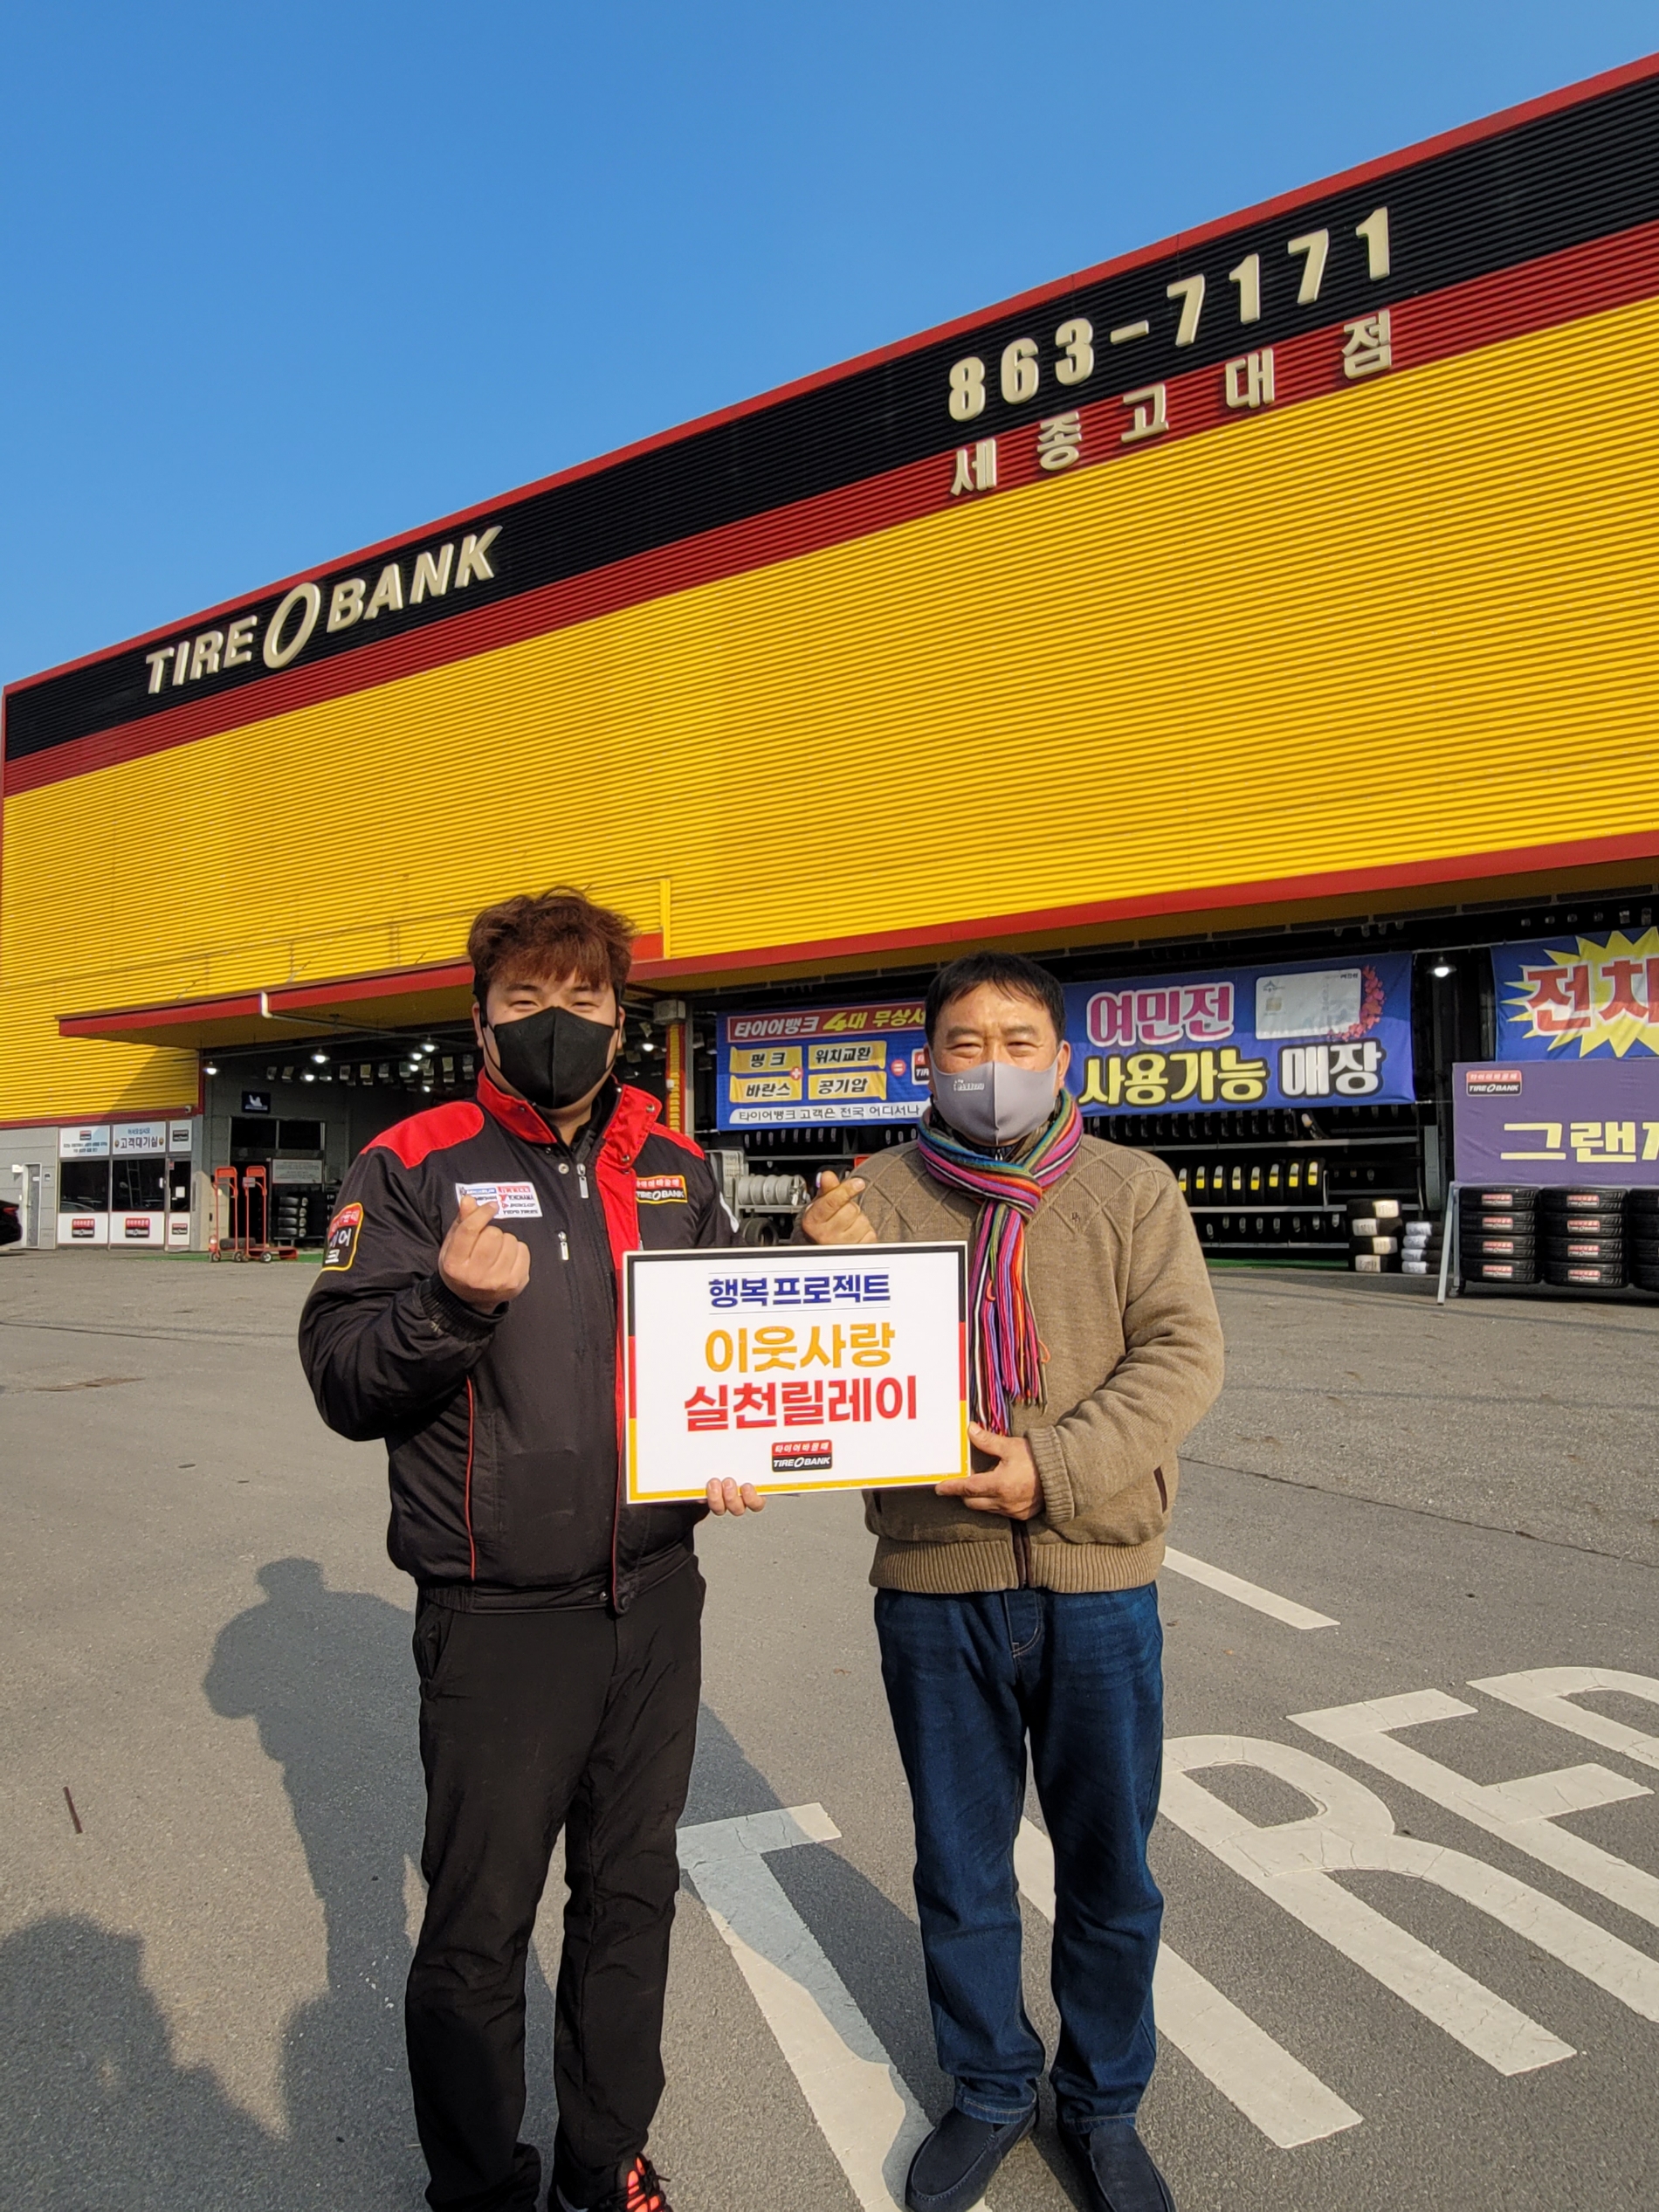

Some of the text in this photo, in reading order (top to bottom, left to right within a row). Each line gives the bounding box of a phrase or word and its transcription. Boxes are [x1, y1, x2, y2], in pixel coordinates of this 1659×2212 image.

[948, 206, 1390, 422] 863-7171
[734, 1016, 820, 1037] 타이어뱅크
[823, 1012, 868, 1032] 4대
[1088, 983, 1233, 1044] 여민전
[815, 1046, 871, 1064] 위치교환
[746, 1083, 790, 1098] 바란스
[818, 1078, 869, 1095] 공기압
[1078, 1044, 1381, 1105] 사용가능 매장
[739, 1105, 919, 1121] 타이어뱅크 고객은 전국 어디서나
[705, 1321, 895, 1373] 이웃사랑
[685, 1375, 917, 1432] 실천릴레이
